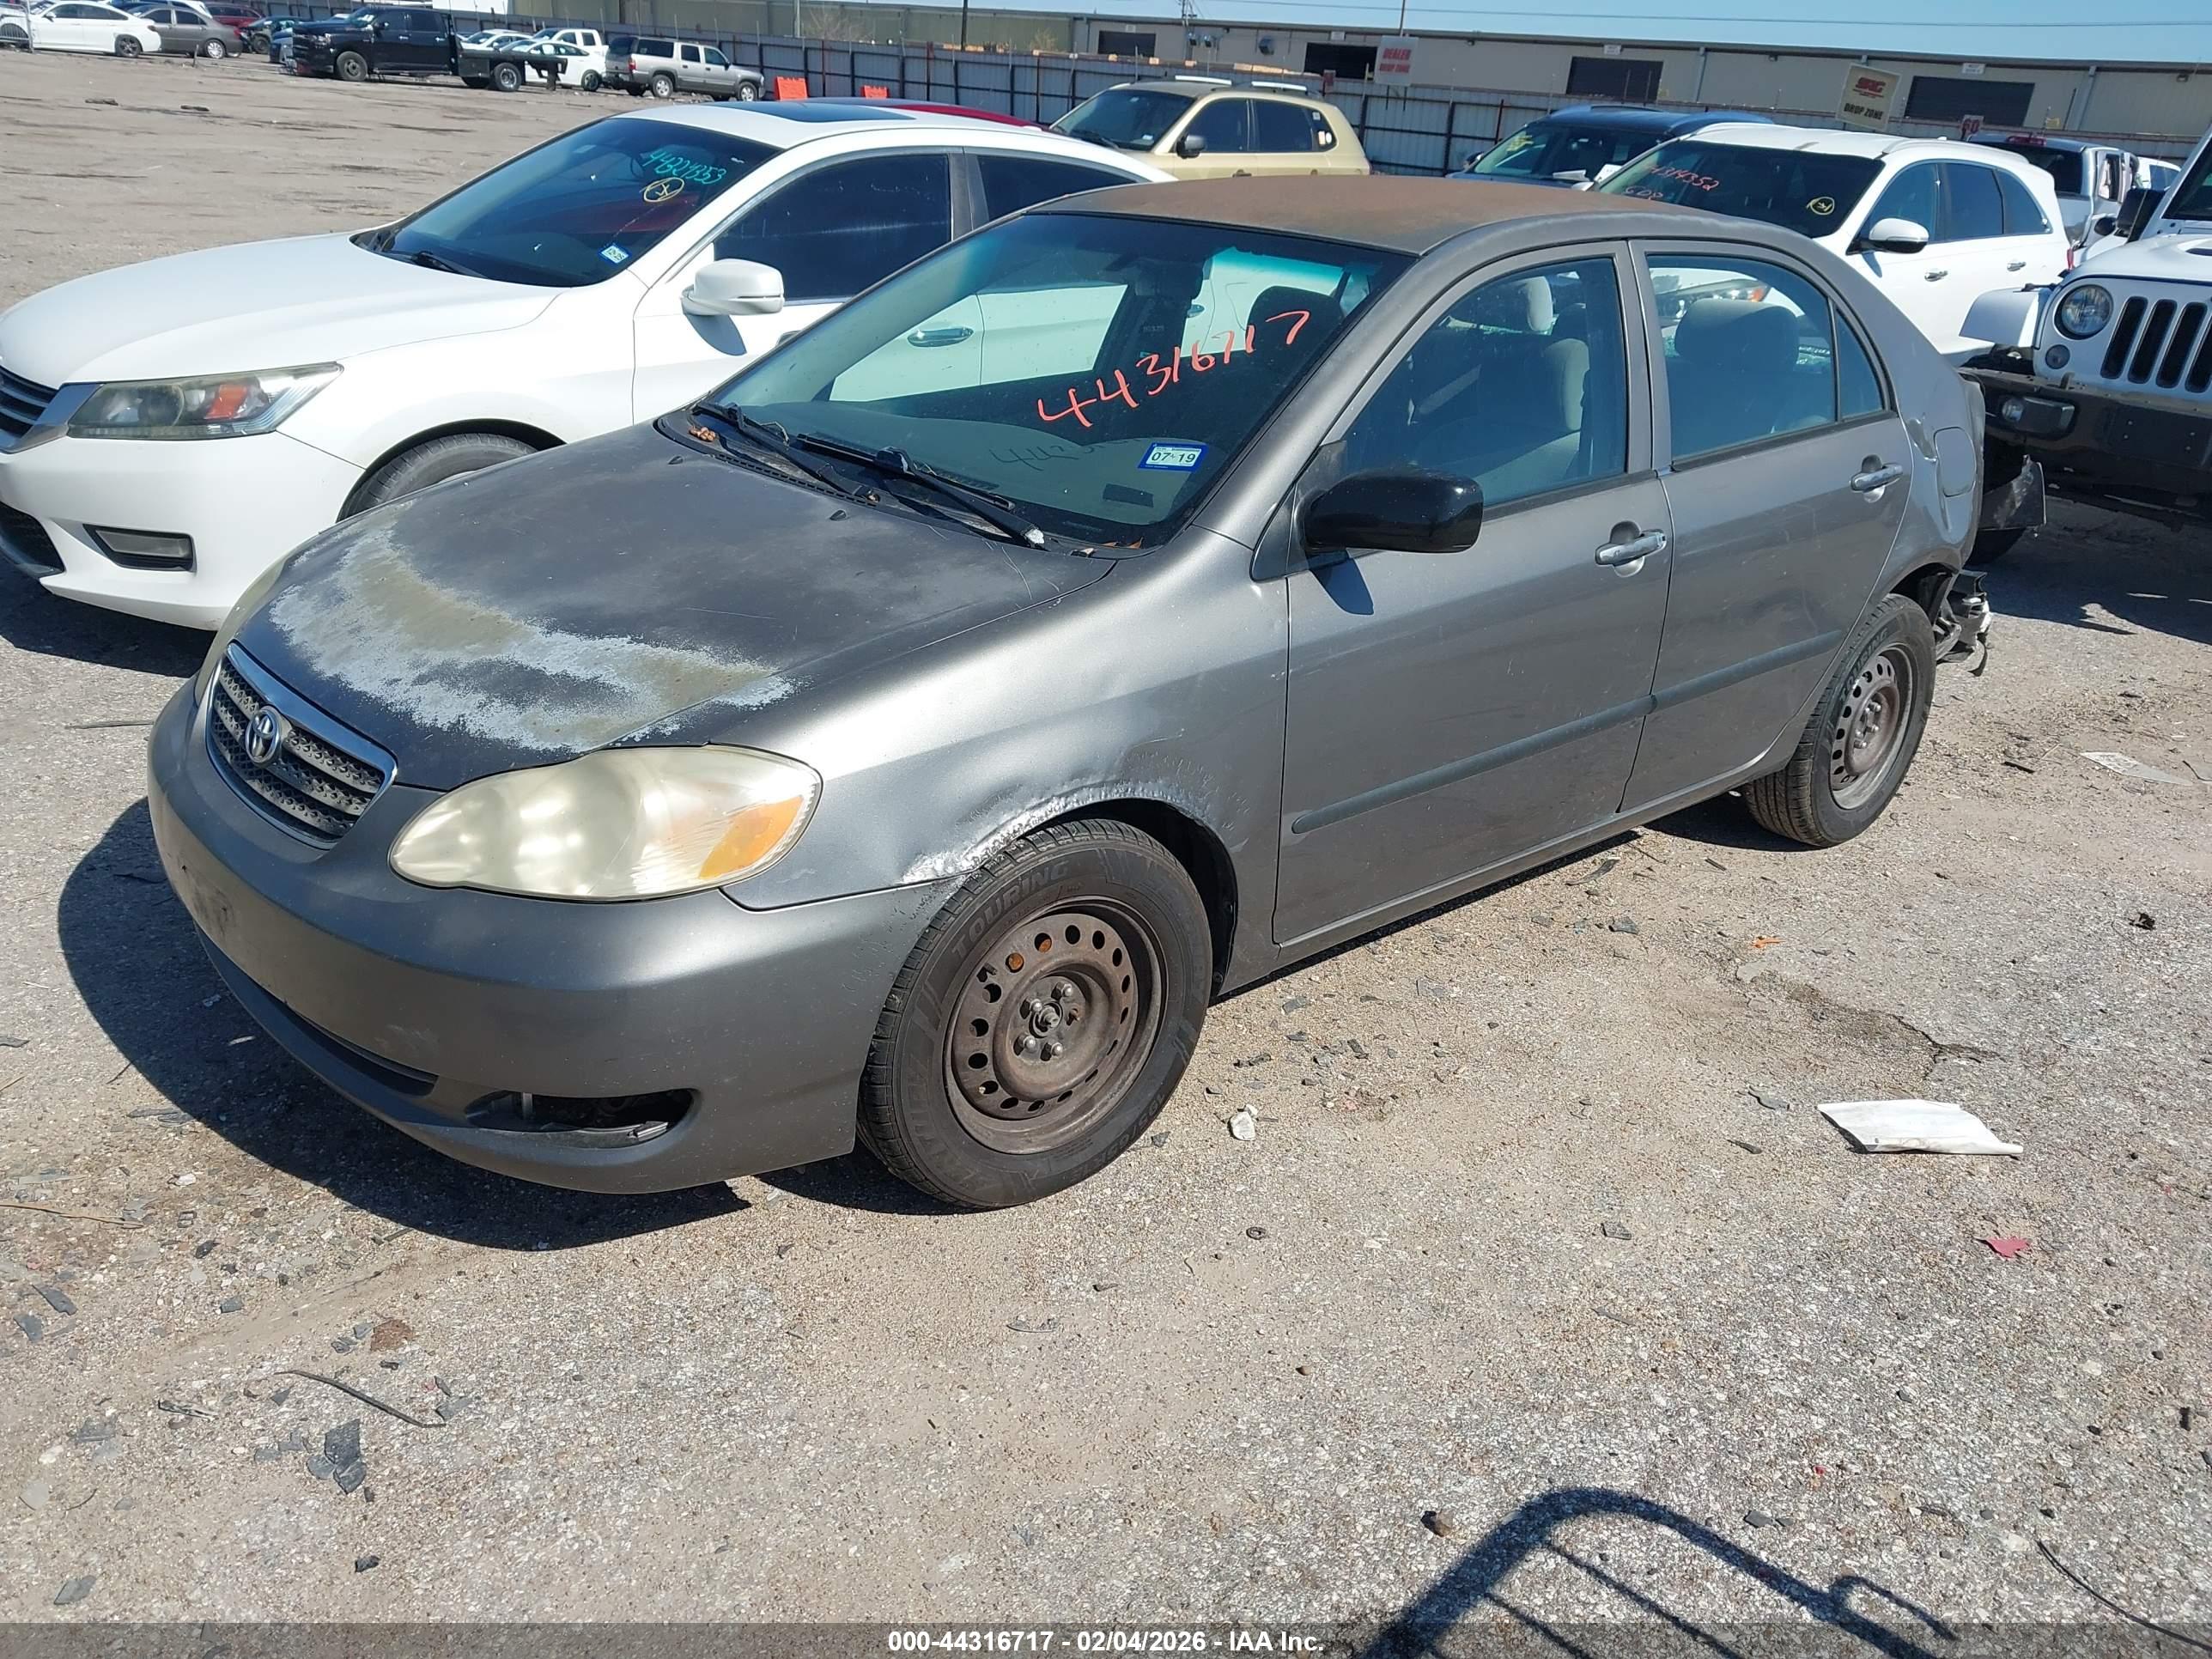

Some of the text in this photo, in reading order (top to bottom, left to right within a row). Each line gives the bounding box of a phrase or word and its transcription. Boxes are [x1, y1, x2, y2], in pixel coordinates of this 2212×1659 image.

[1382, 48, 1412, 60] DEALER
[1844, 102, 1884, 120] DROP ZONE
[1036, 309, 1310, 428] 44316717
[1151, 451, 1196, 463] 07 19
[1839, 627, 1889, 703] TOURING
[951, 860, 1072, 959] TOURING
